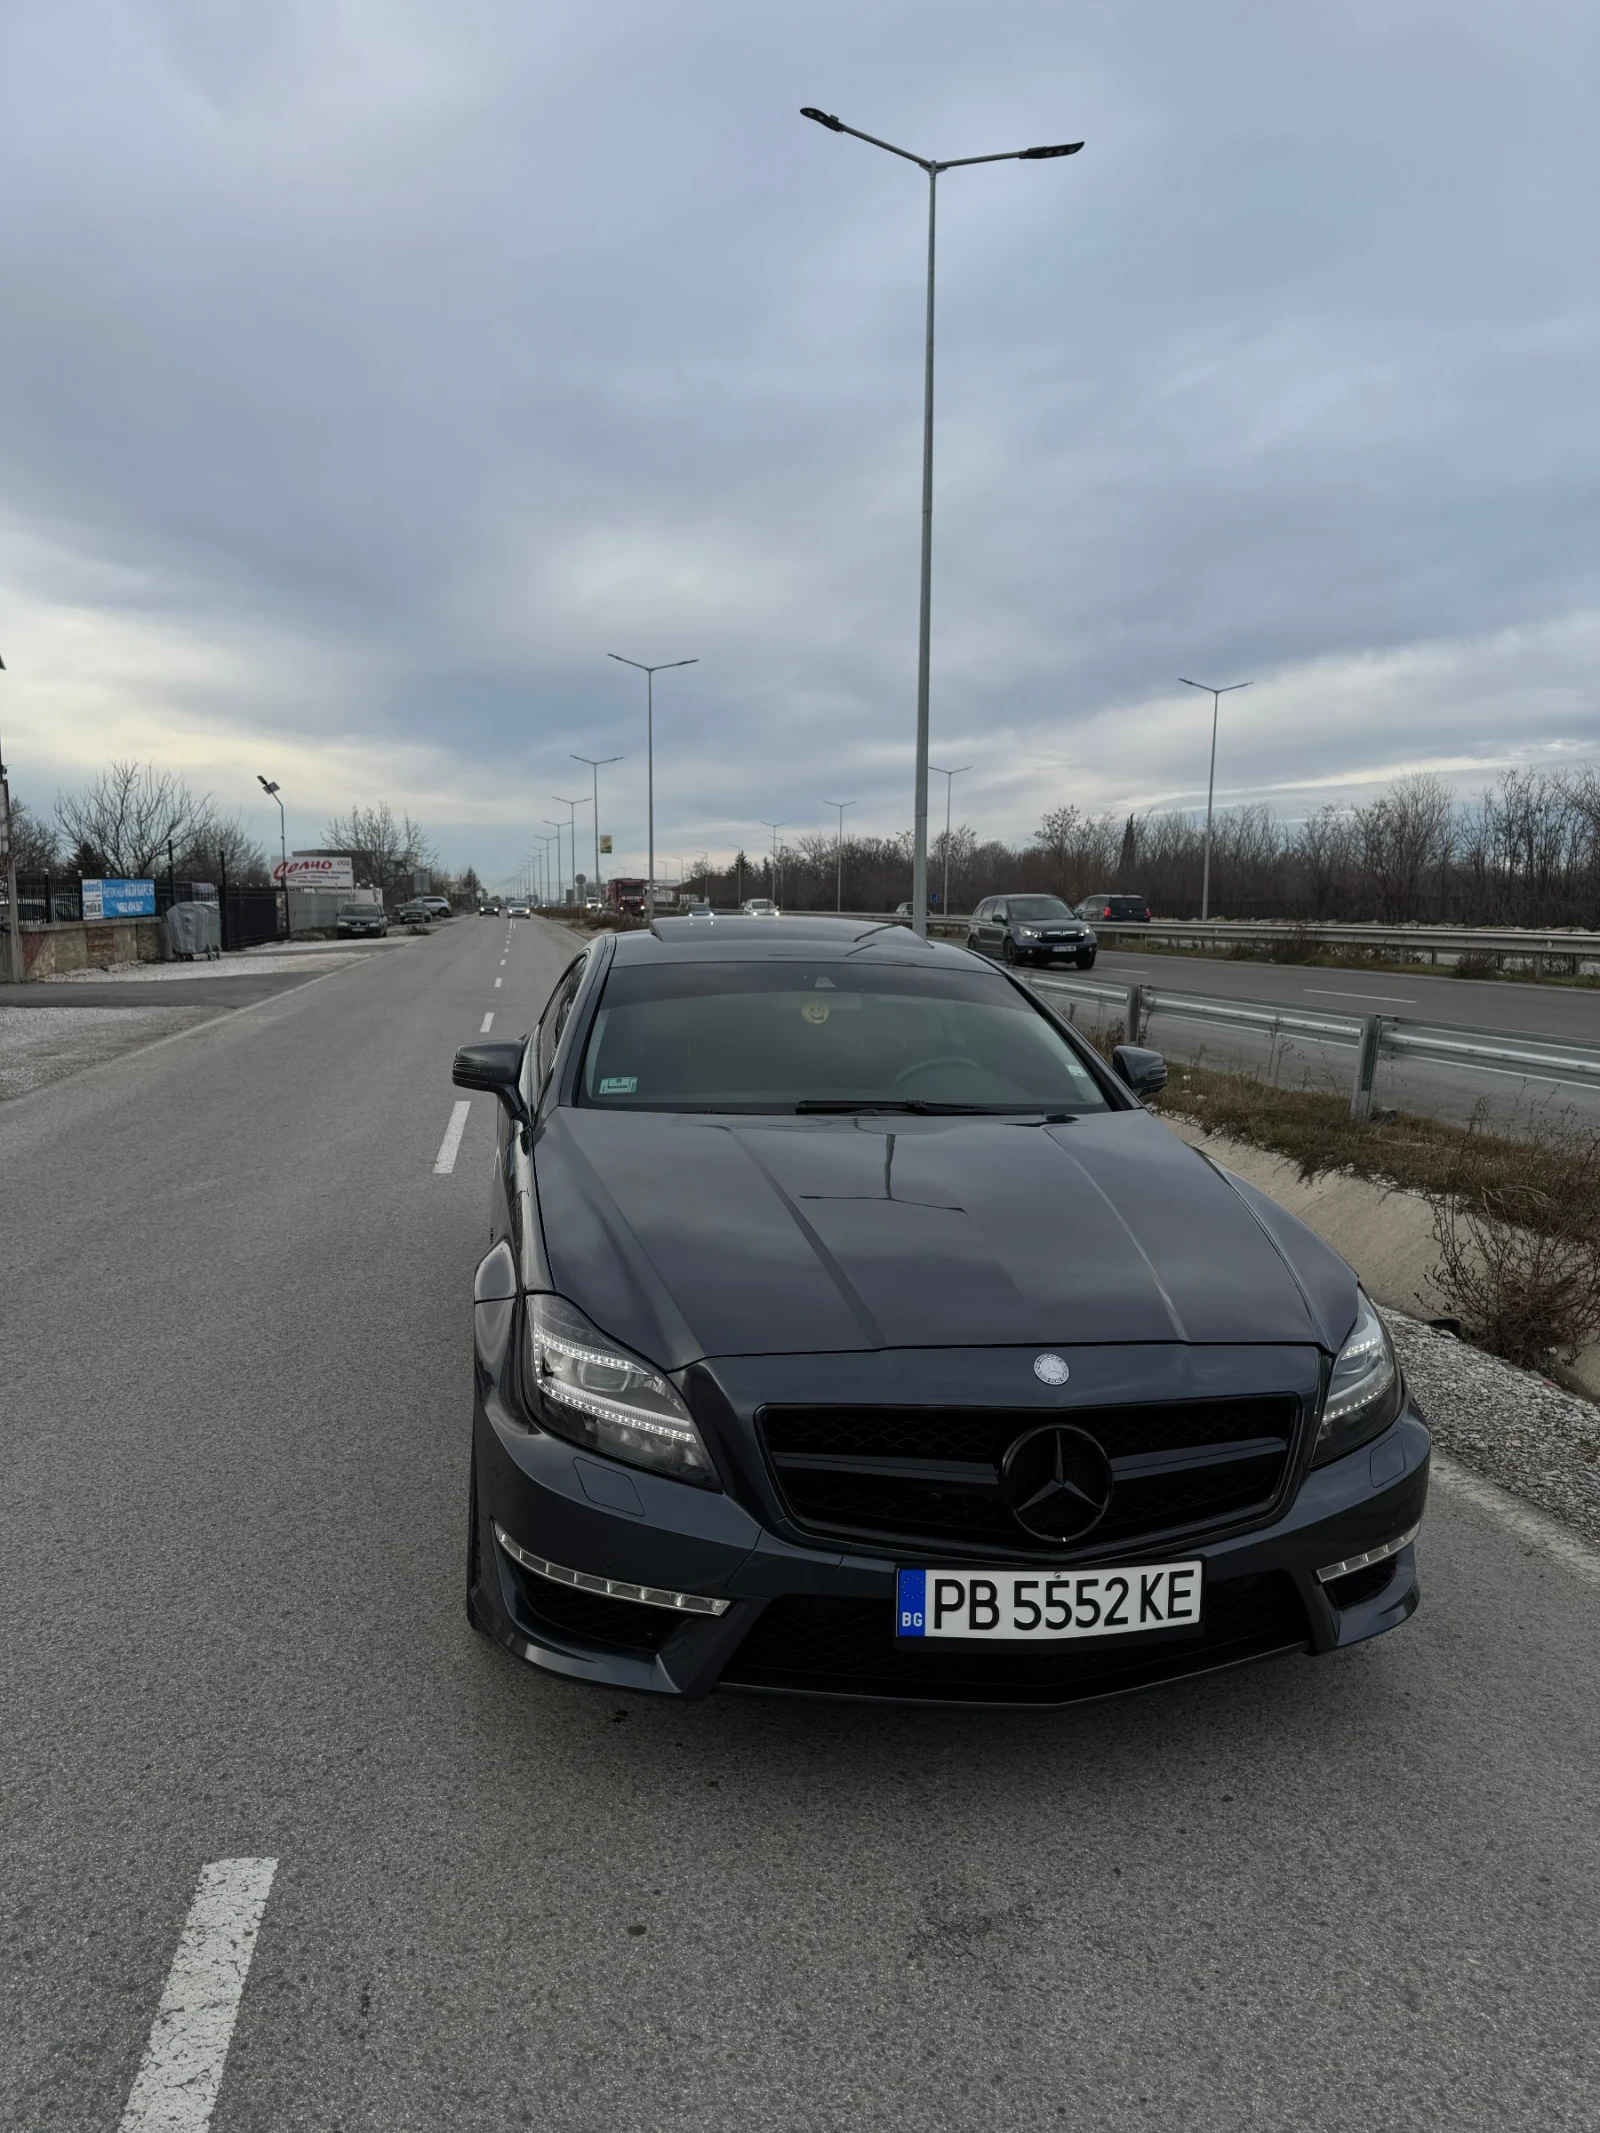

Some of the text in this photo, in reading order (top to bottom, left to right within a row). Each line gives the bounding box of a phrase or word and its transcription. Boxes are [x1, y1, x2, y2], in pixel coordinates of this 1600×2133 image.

[901, 1611, 923, 1628] BG
[934, 1569, 1195, 1631] PB 5552 KE
